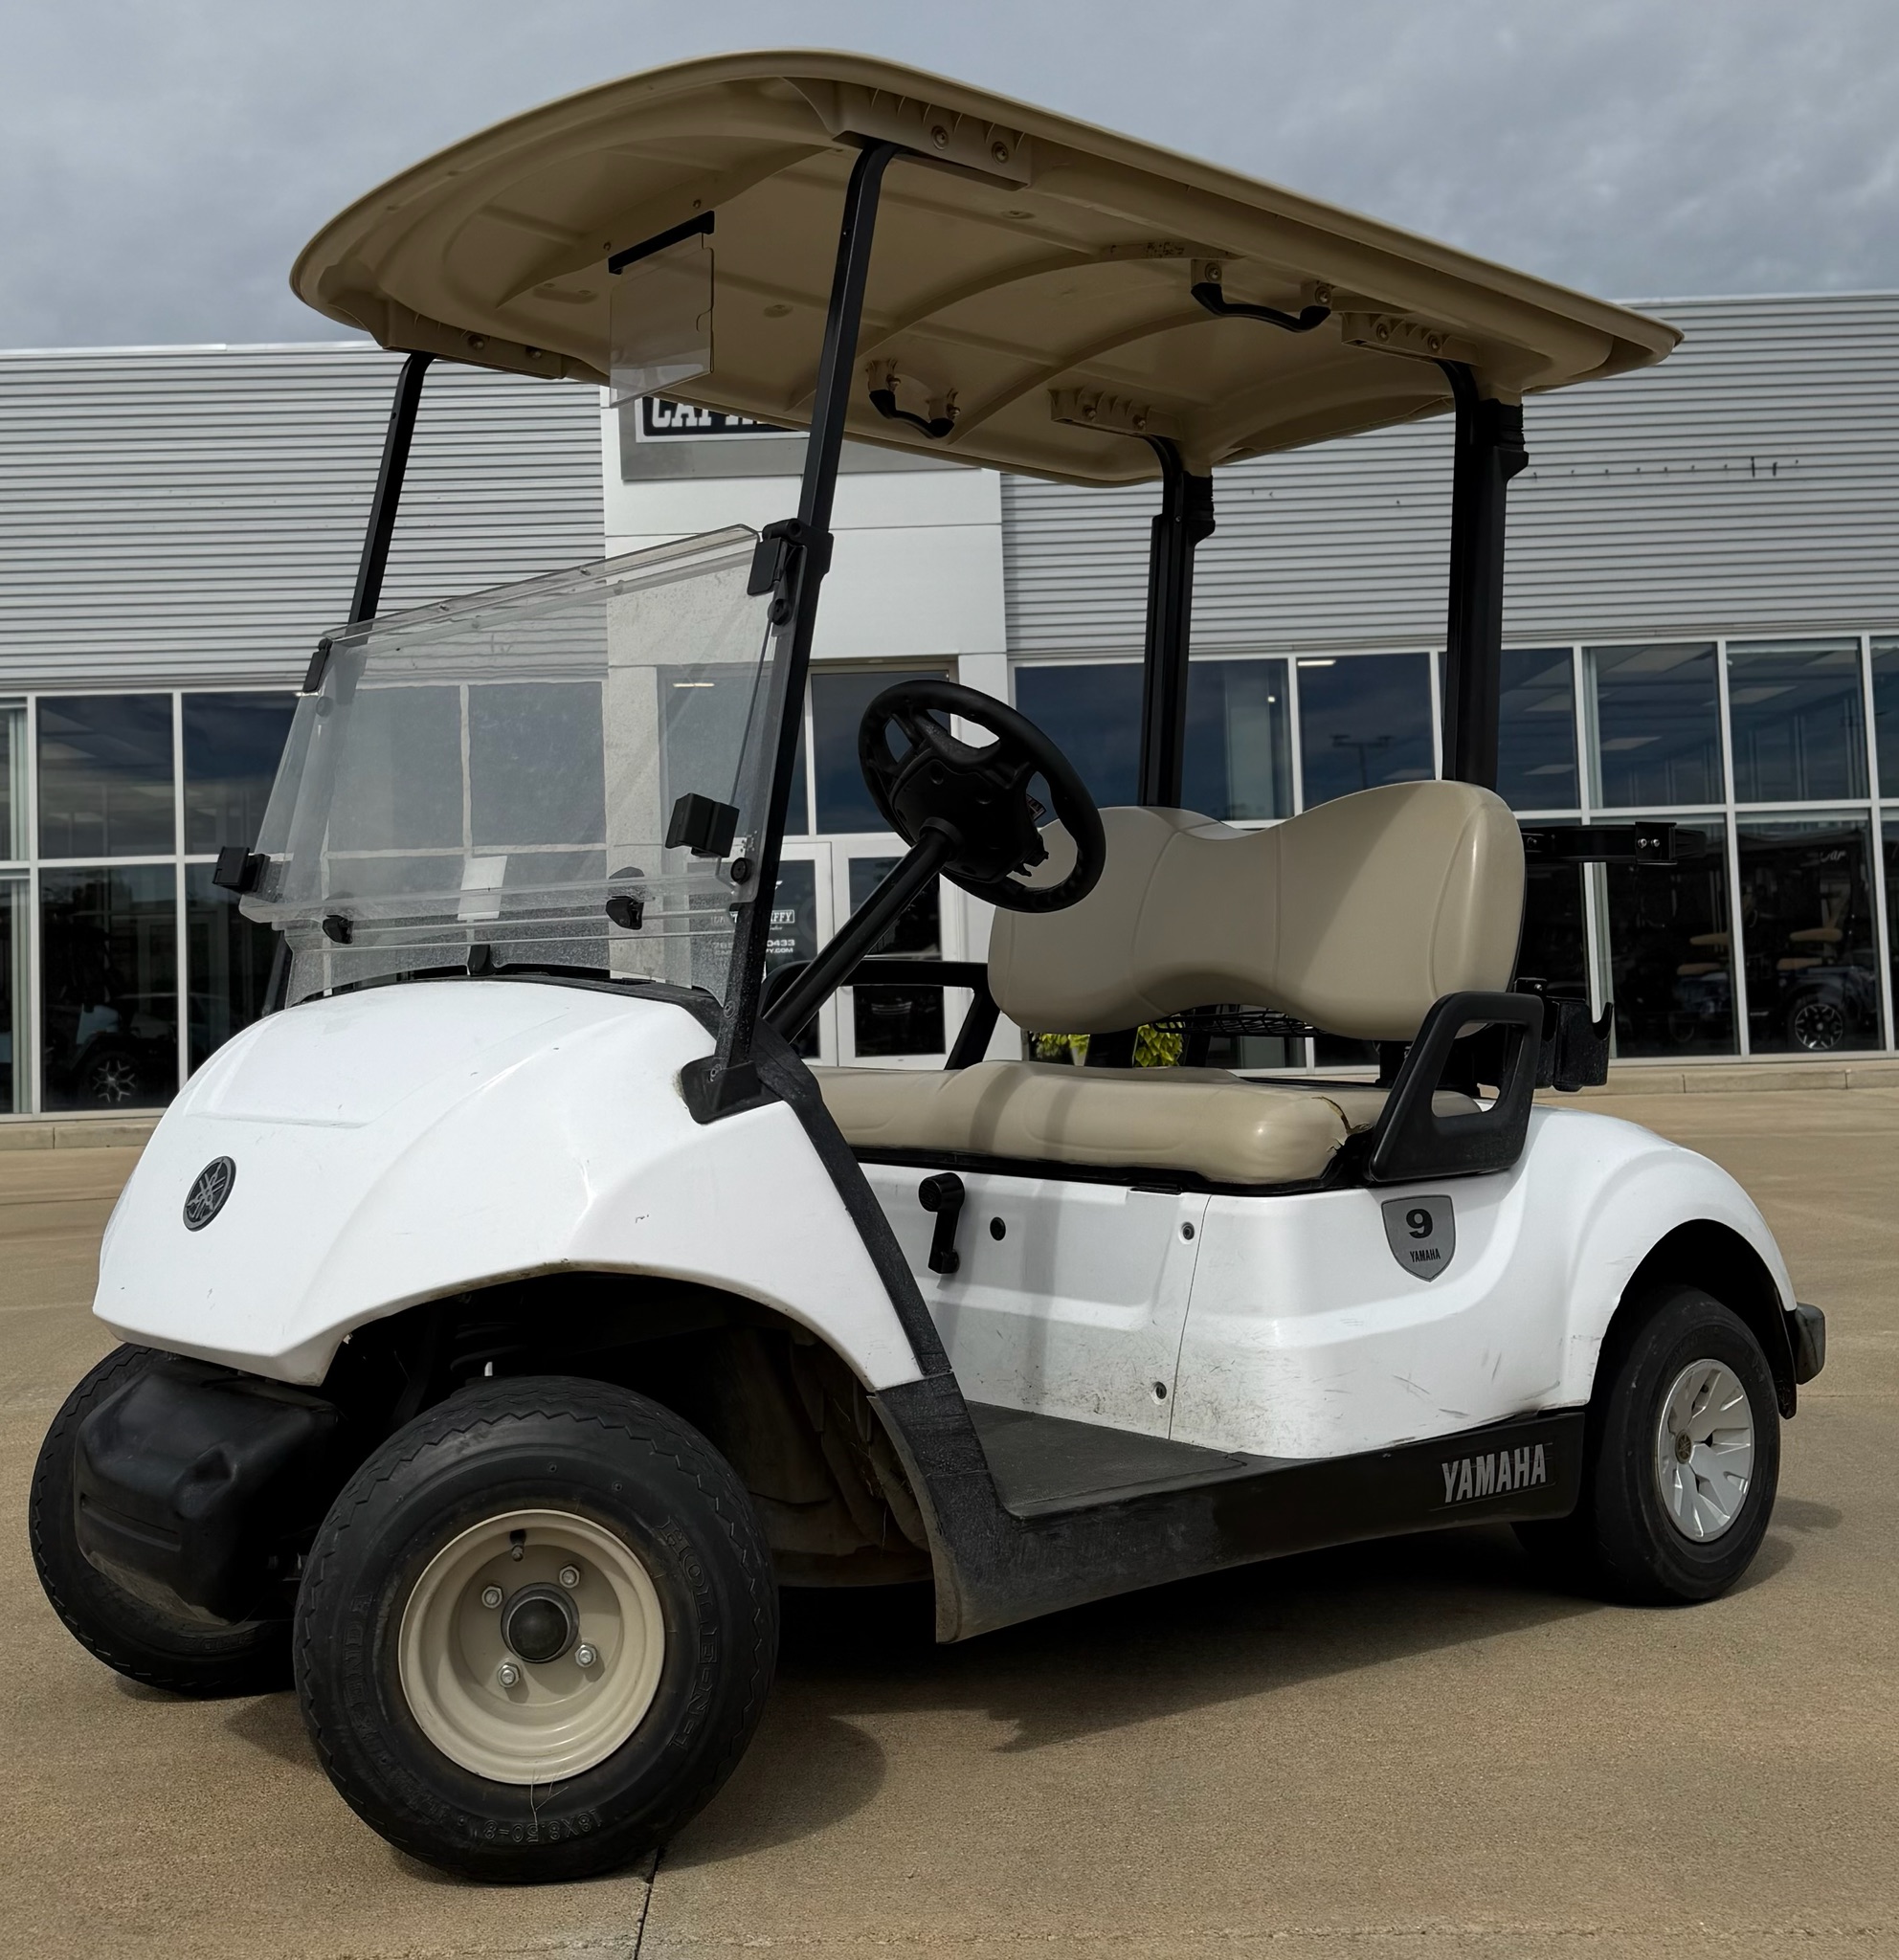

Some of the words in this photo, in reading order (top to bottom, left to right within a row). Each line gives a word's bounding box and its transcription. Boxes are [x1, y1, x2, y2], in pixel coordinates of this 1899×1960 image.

[1405, 1208, 1433, 1238] 9
[1409, 1248, 1441, 1263] YAMAHA
[1441, 1443, 1547, 1503] YAMAHA
